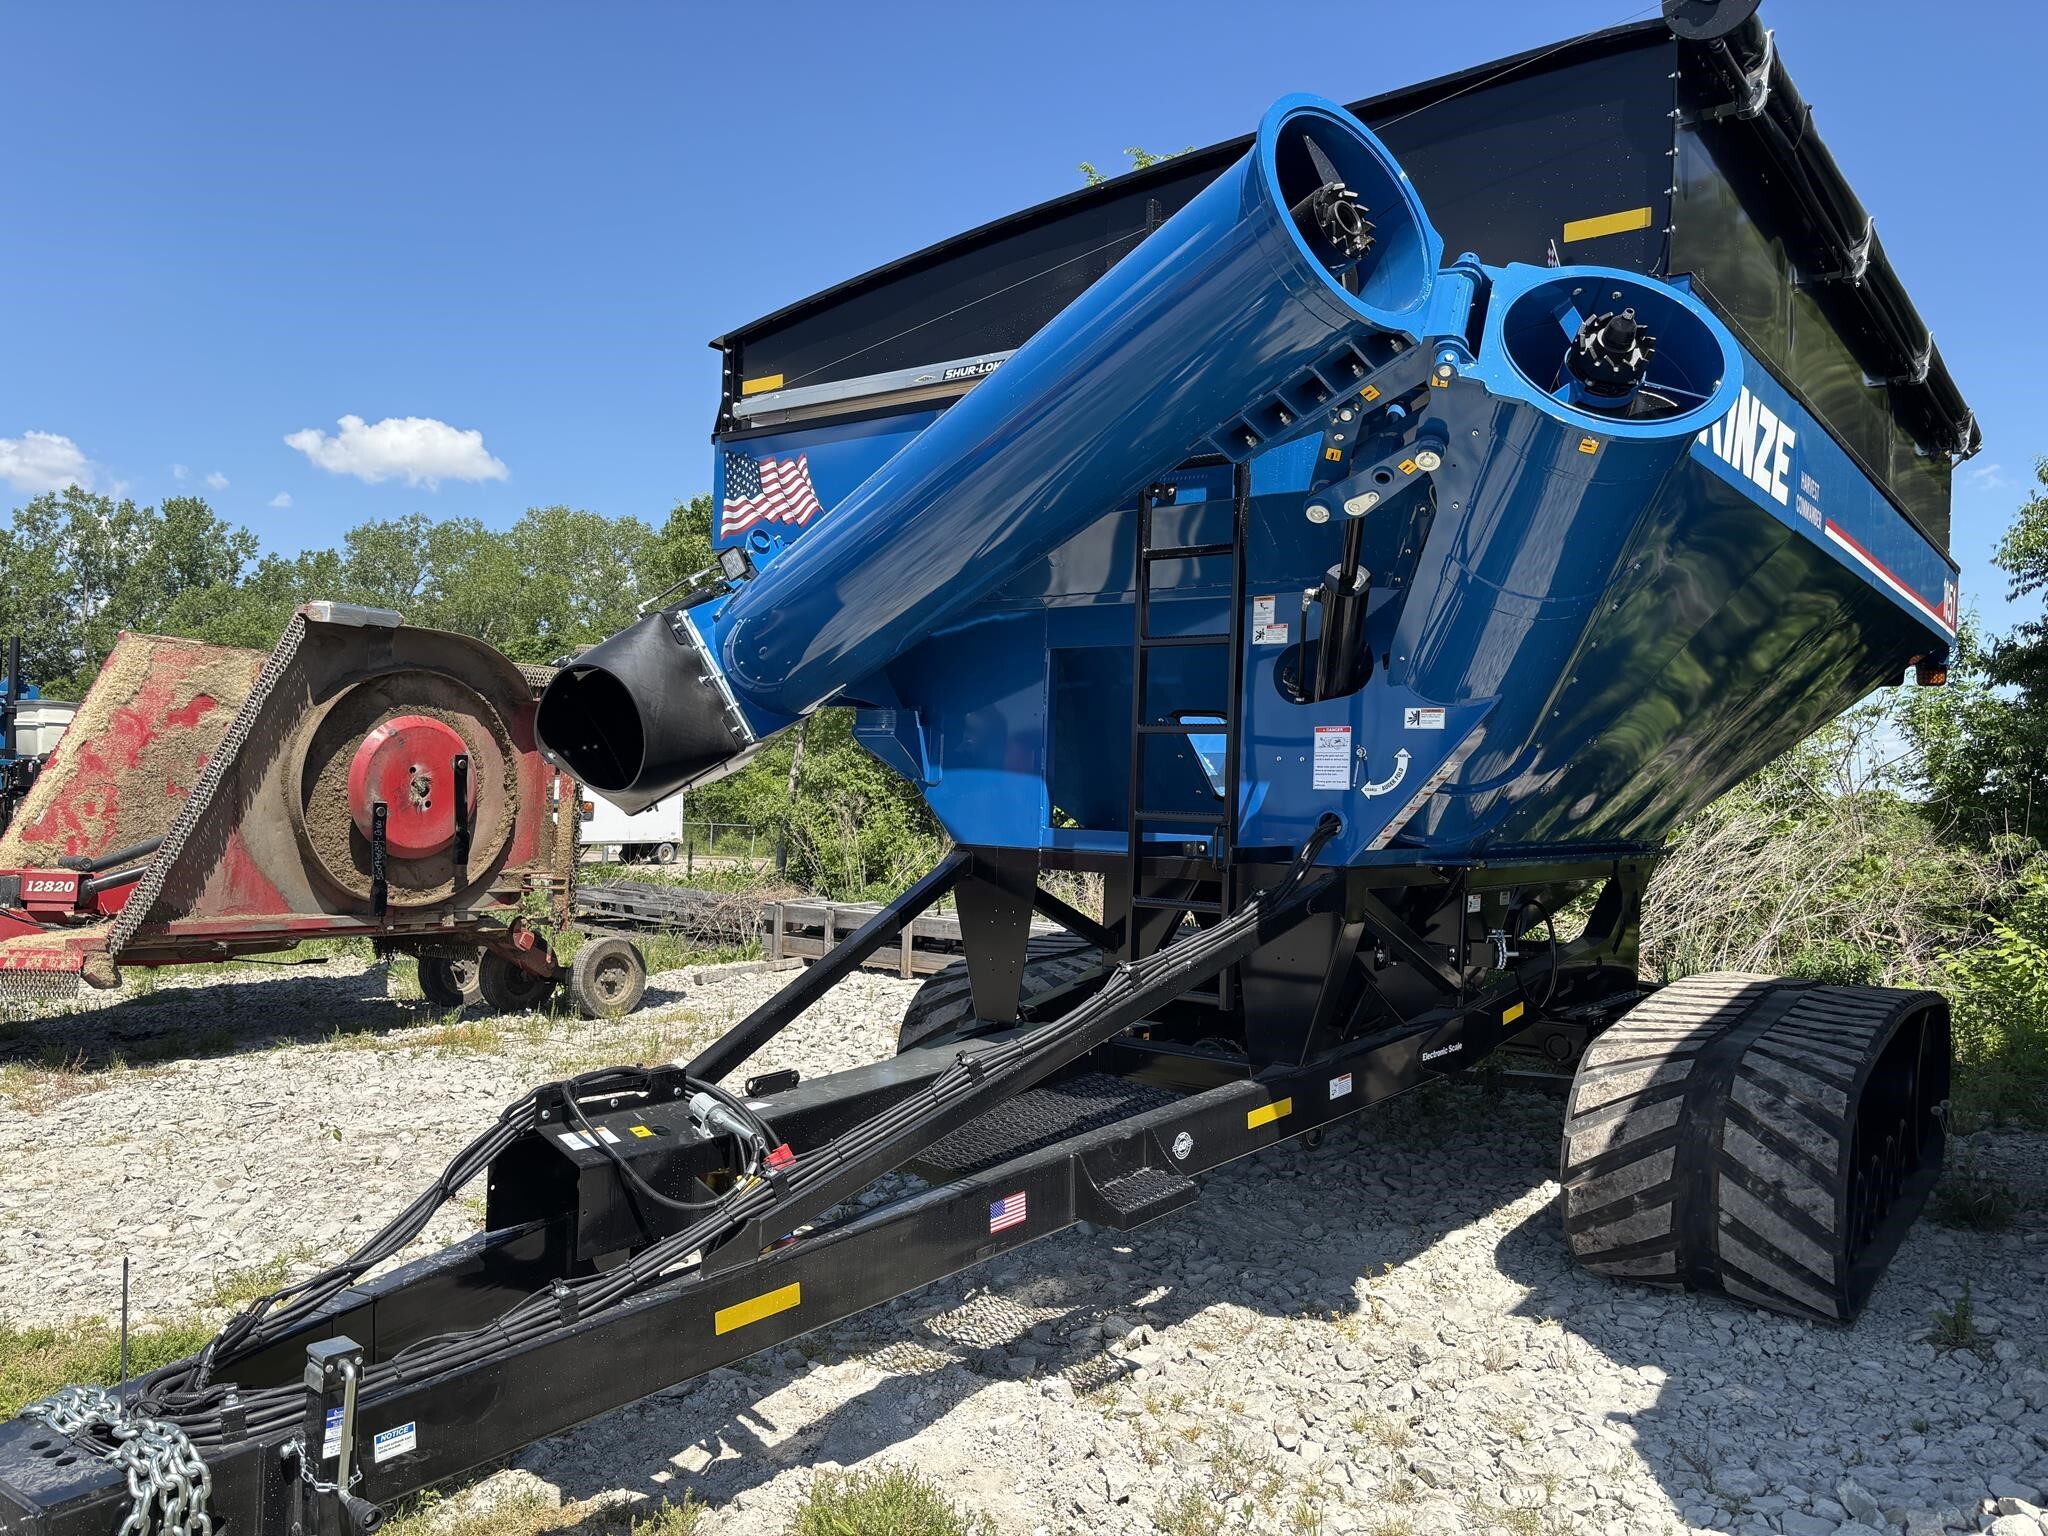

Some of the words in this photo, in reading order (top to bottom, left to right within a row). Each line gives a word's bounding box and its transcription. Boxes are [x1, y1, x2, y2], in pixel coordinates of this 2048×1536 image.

[1381, 779, 1397, 791] AUGER
[1394, 767, 1404, 781] FOLD
[26, 880, 75, 893] 12820
[1422, 1046, 1448, 1061] Electronic
[1448, 1042, 1463, 1053] Scale
[380, 1427, 409, 1442] NOTICE
